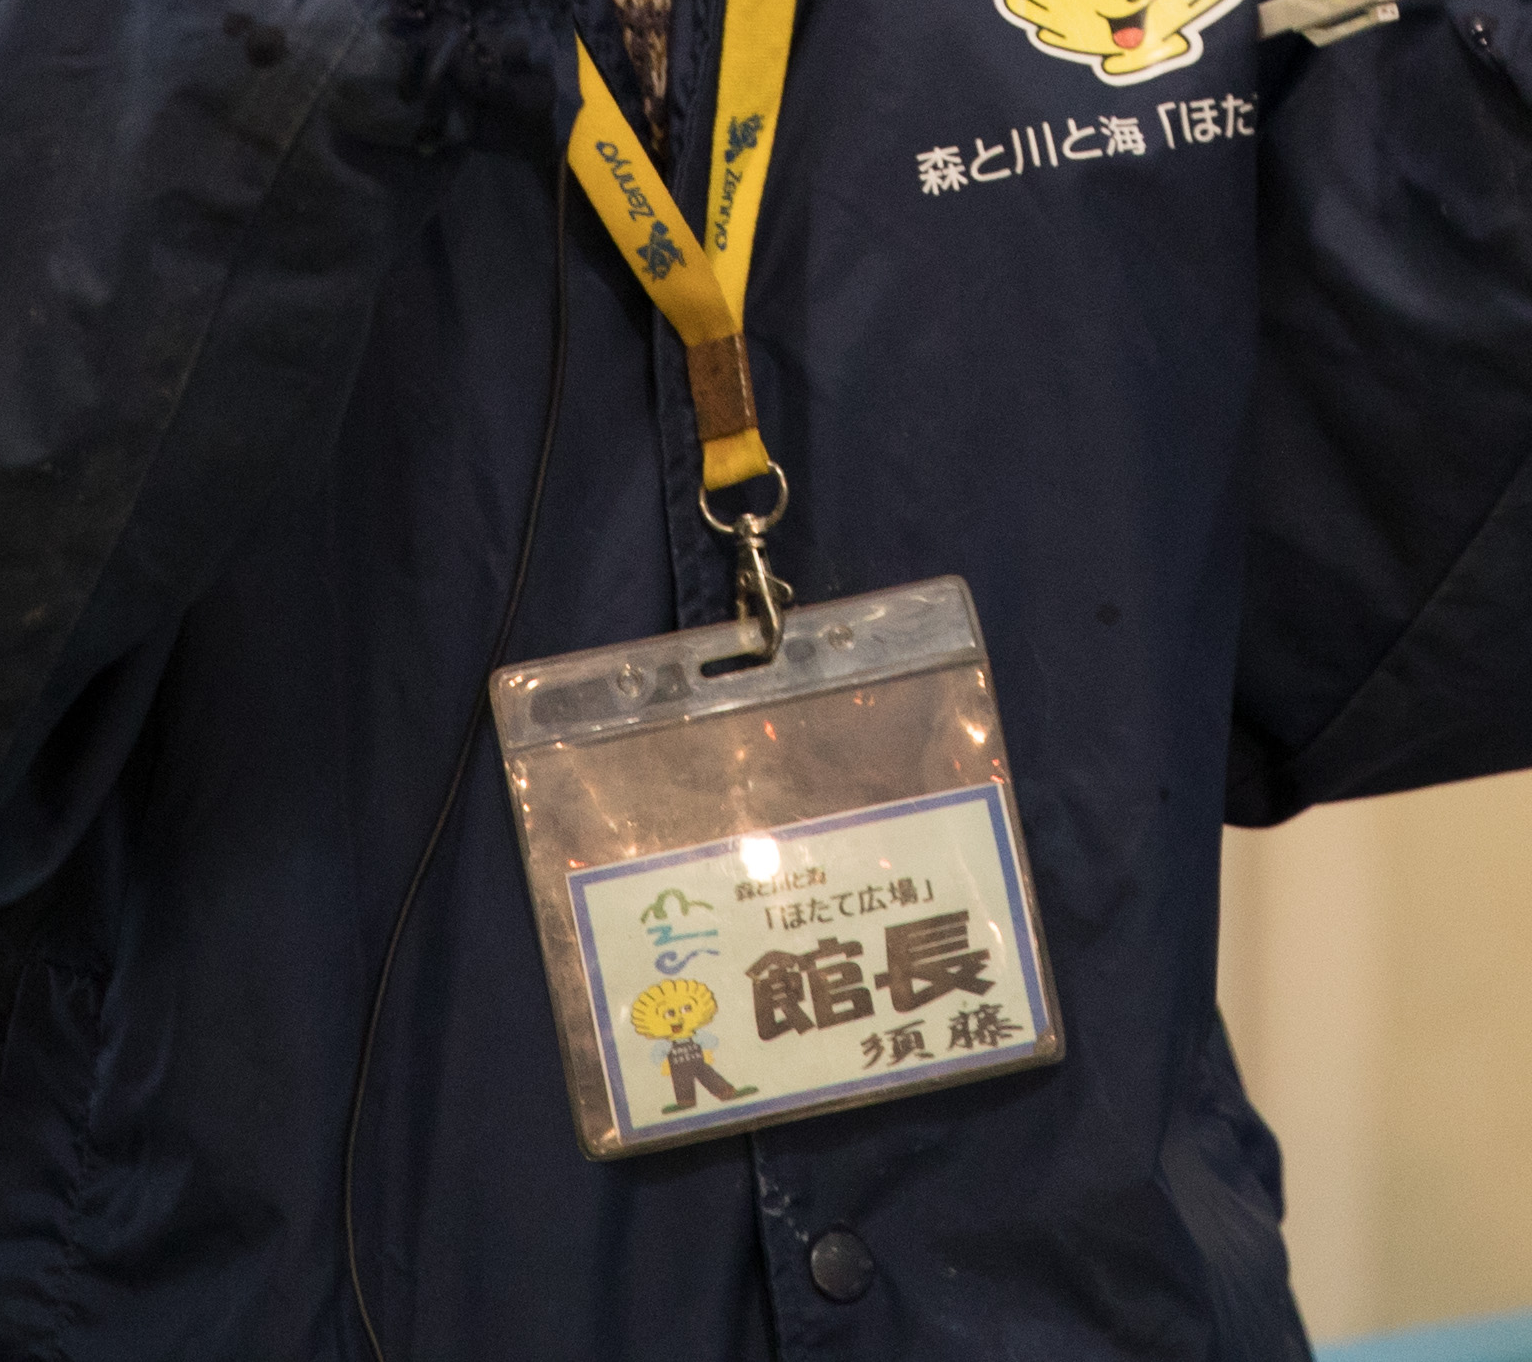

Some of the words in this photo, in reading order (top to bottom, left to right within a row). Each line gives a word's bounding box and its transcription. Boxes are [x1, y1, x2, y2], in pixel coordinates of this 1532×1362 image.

[596, 140, 655, 222] Zenryo
[915, 92, 1258, 196] 森と川と海「ほた
[764, 877, 935, 930] 「ほたて広場」
[744, 910, 996, 1042] 館長
